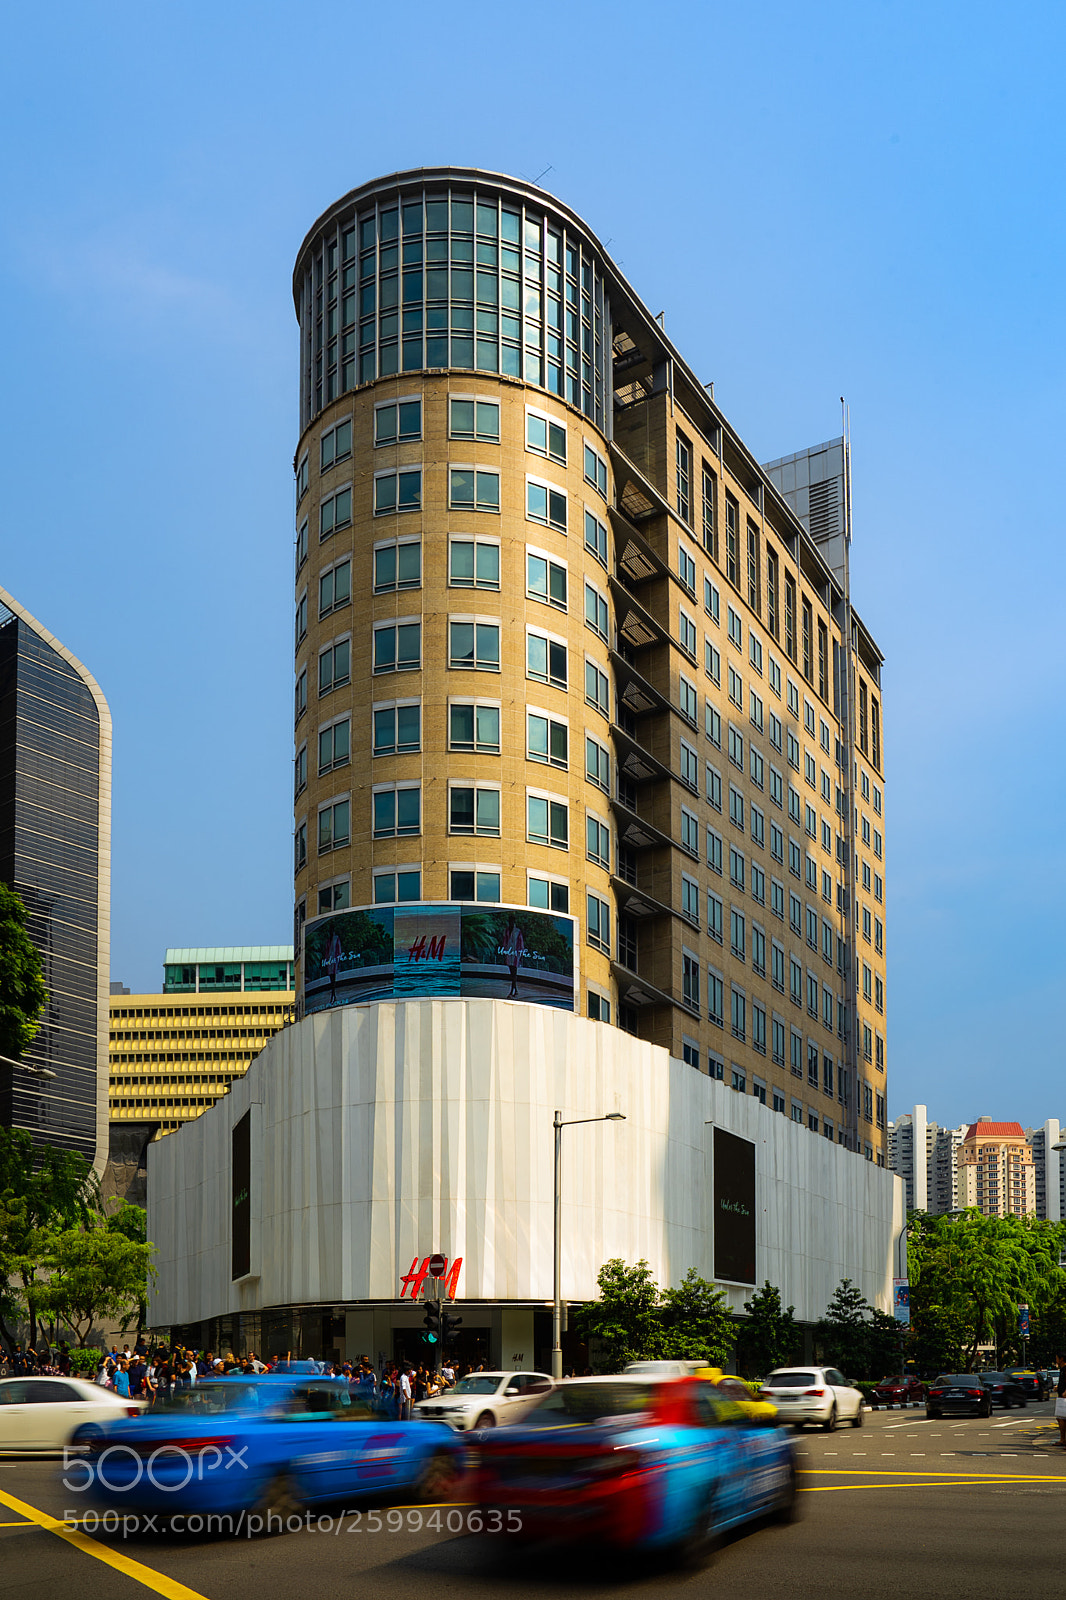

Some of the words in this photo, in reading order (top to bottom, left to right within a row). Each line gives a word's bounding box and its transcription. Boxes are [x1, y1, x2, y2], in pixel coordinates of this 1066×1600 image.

[348, 951, 361, 960] Sun
[408, 935, 447, 962] H&M
[497, 946, 518, 956] Under
[532, 951, 546, 961] Sun
[400, 1257, 463, 1300] HM
